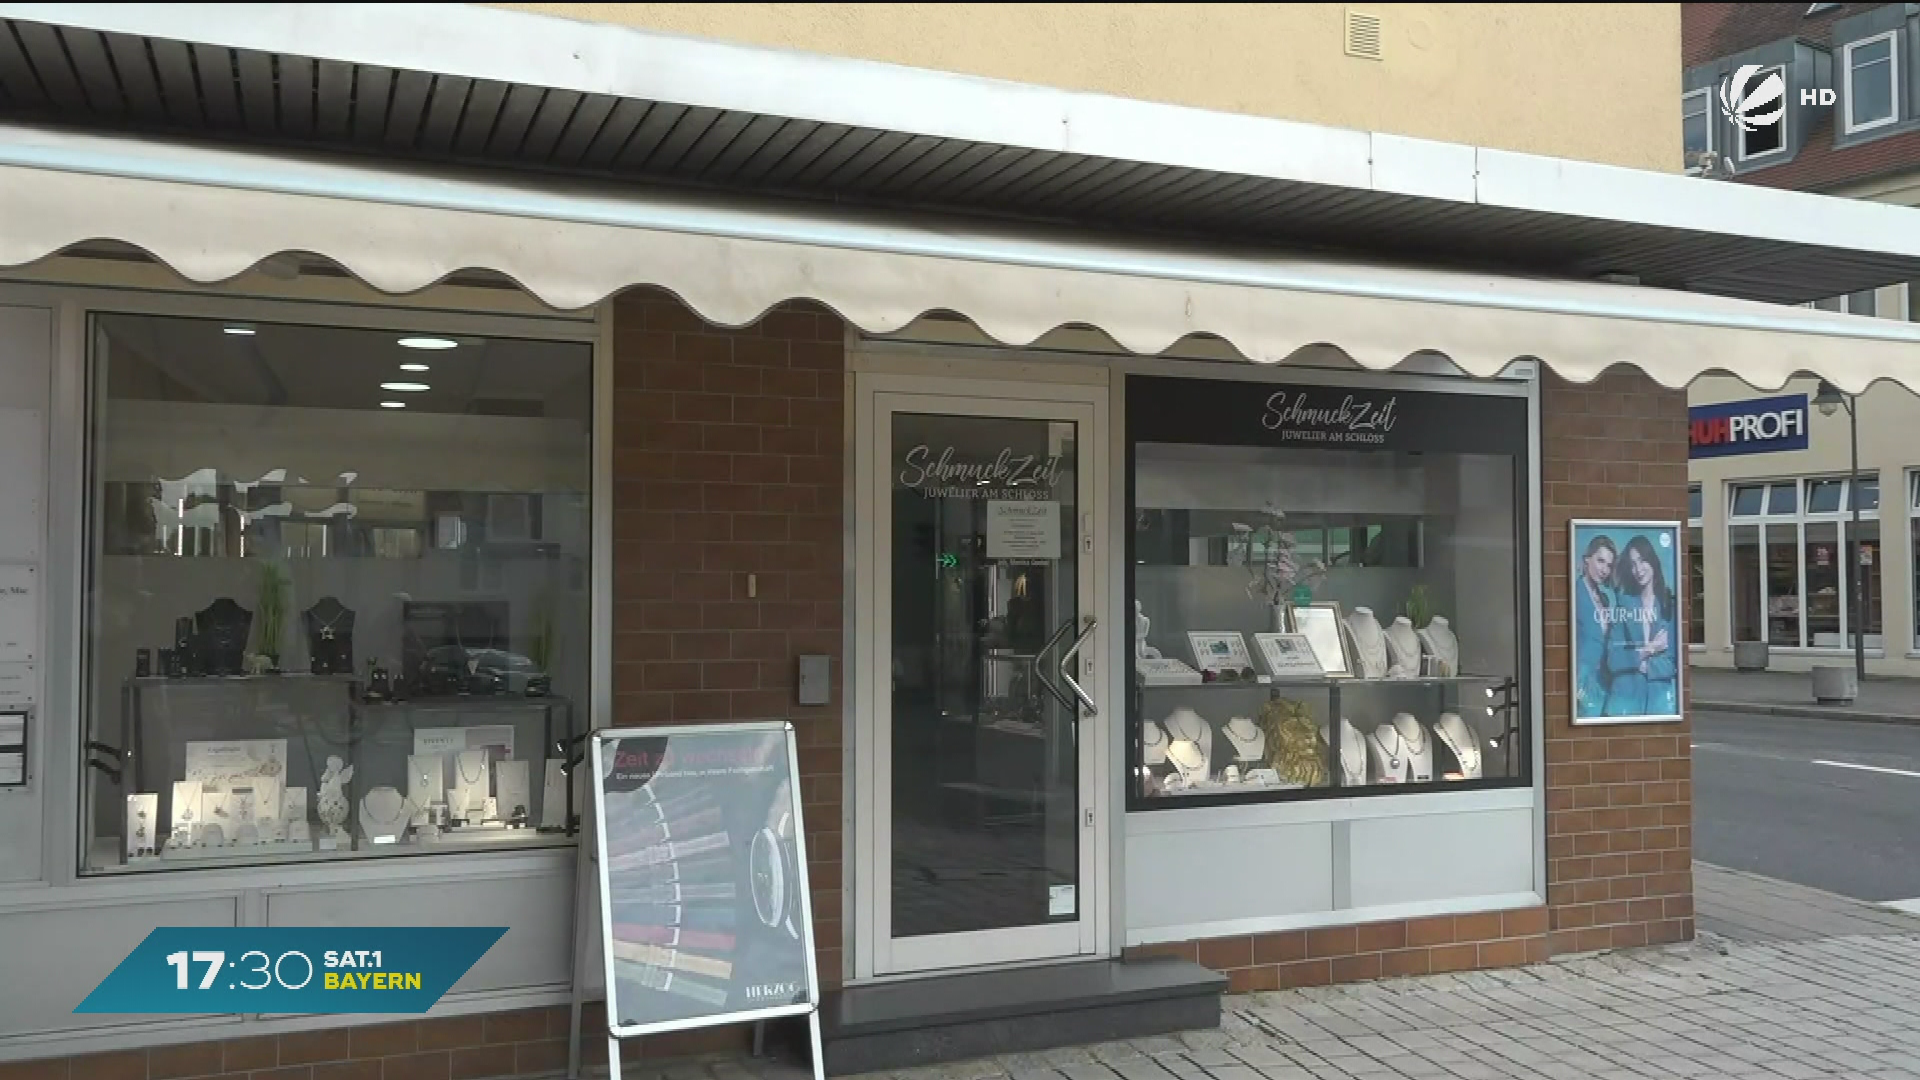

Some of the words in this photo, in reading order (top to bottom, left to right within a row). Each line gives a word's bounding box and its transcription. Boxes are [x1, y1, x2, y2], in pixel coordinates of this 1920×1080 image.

[1281, 430, 1327, 442] JUWELIER
[1328, 432, 1343, 443] AM
[1344, 432, 1385, 444] SCHLOSS
[923, 486, 979, 500] JUWELIER
[981, 487, 999, 499] AM
[1001, 488, 1049, 501] SCHLOSS
[1633, 606, 1658, 623] LION
[615, 750, 648, 768] Zeit
